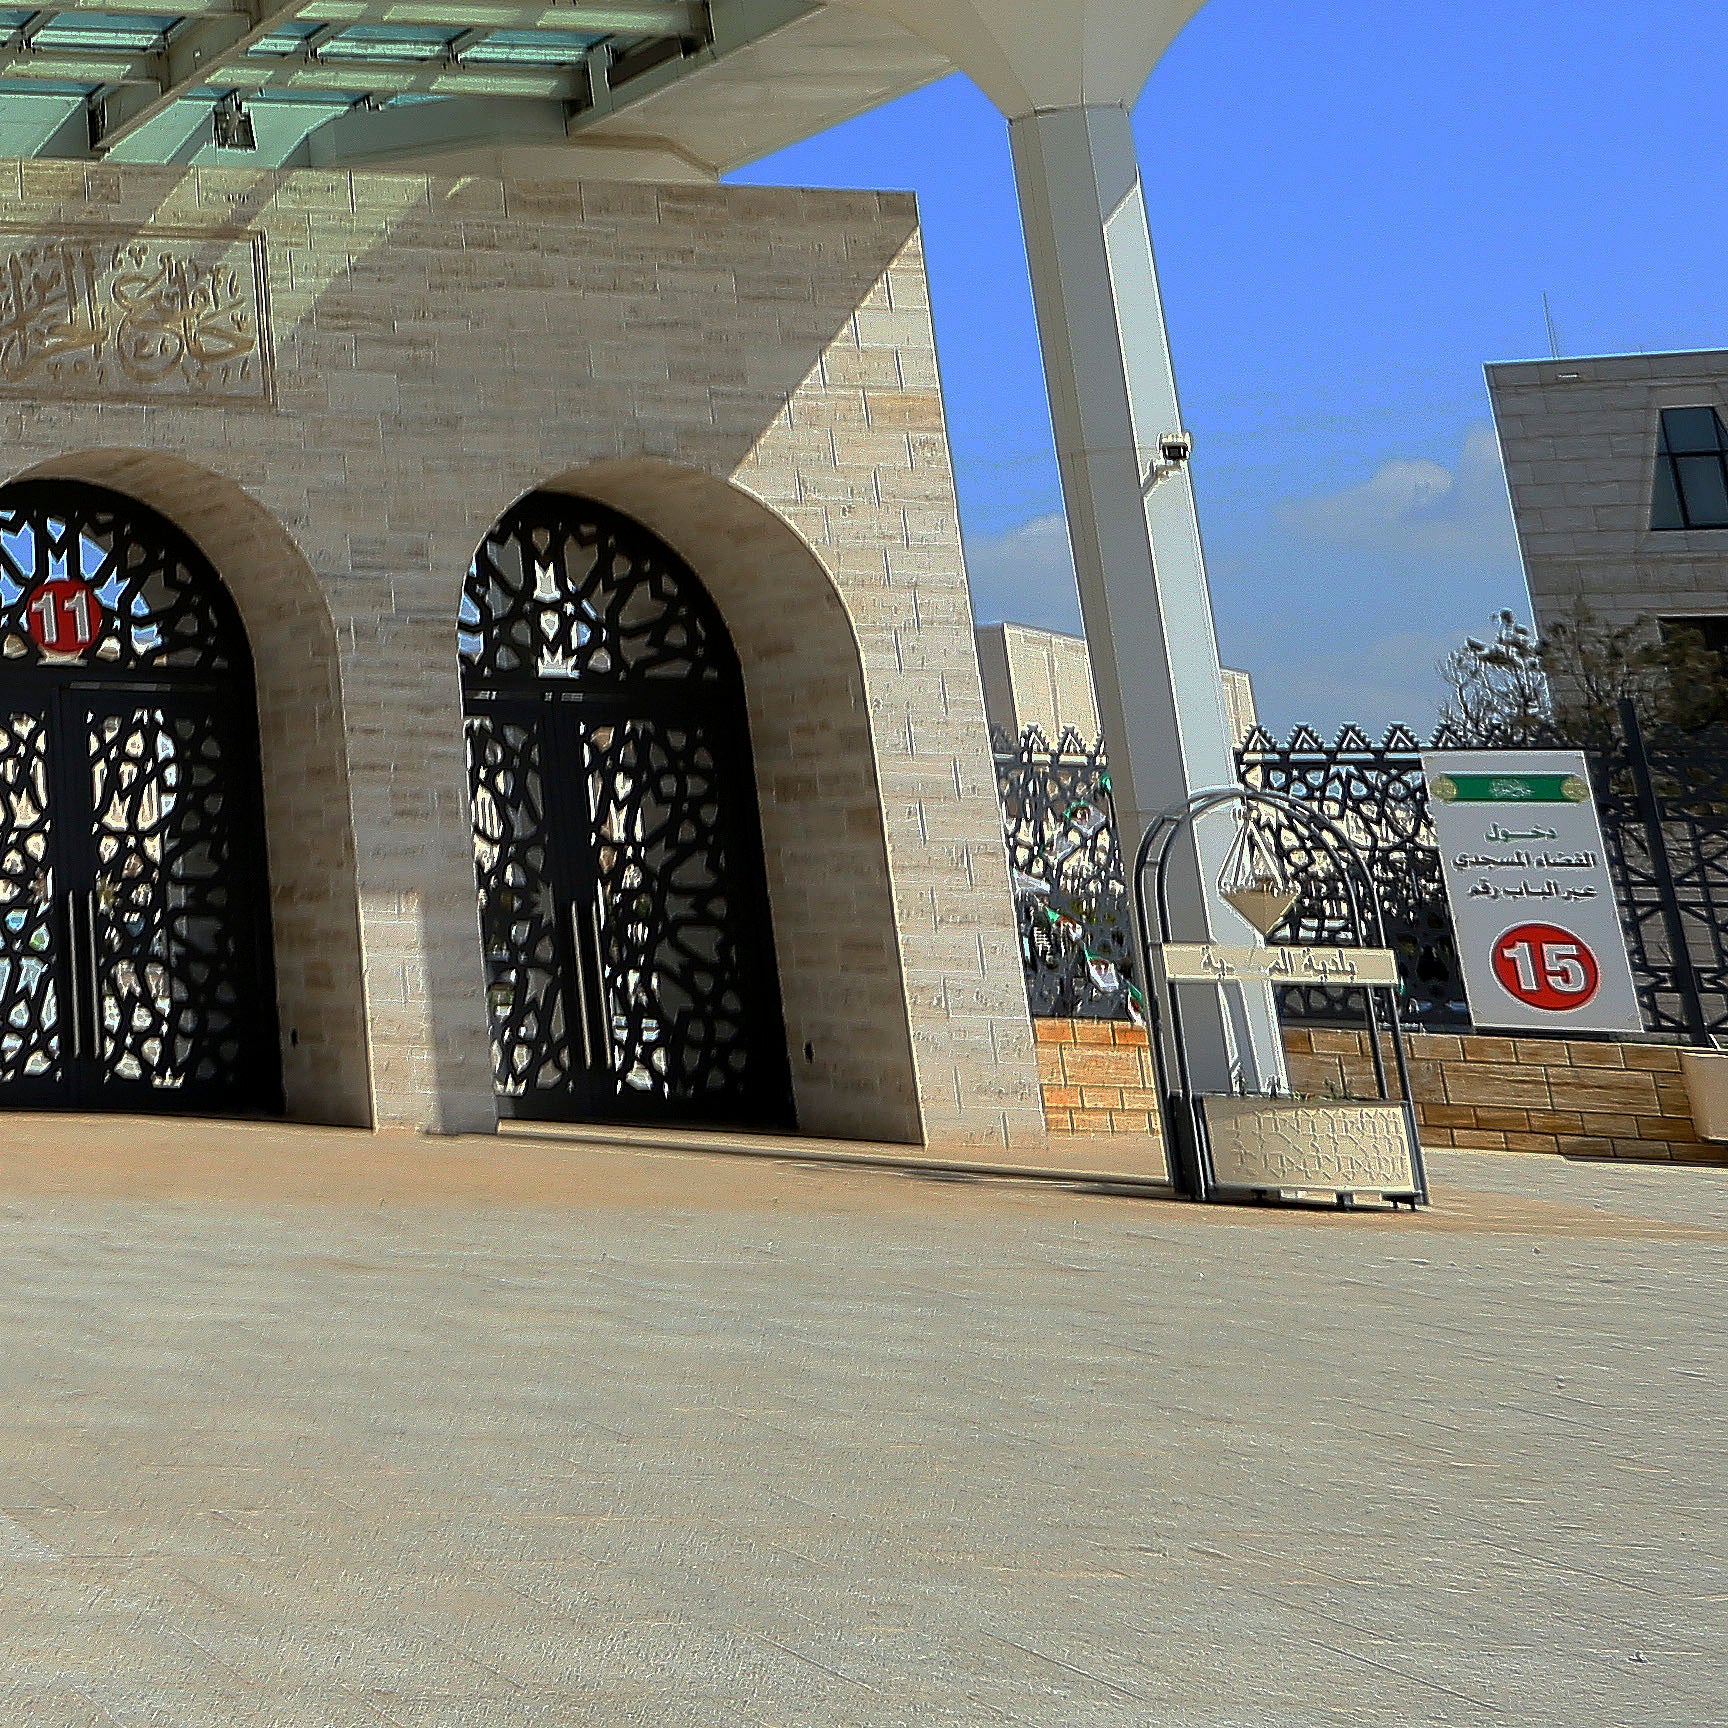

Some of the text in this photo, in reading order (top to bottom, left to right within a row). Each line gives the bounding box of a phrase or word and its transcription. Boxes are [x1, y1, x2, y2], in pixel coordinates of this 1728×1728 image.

[31, 590, 90, 644] 11
[1484, 823, 1558, 843] دخول
[1452, 851, 1597, 872] الفضاء المسجدي
[1468, 878, 1597, 902] عبر الباب رقم
[1301, 947, 1357, 982] بلدية
[1502, 941, 1585, 992] 15
